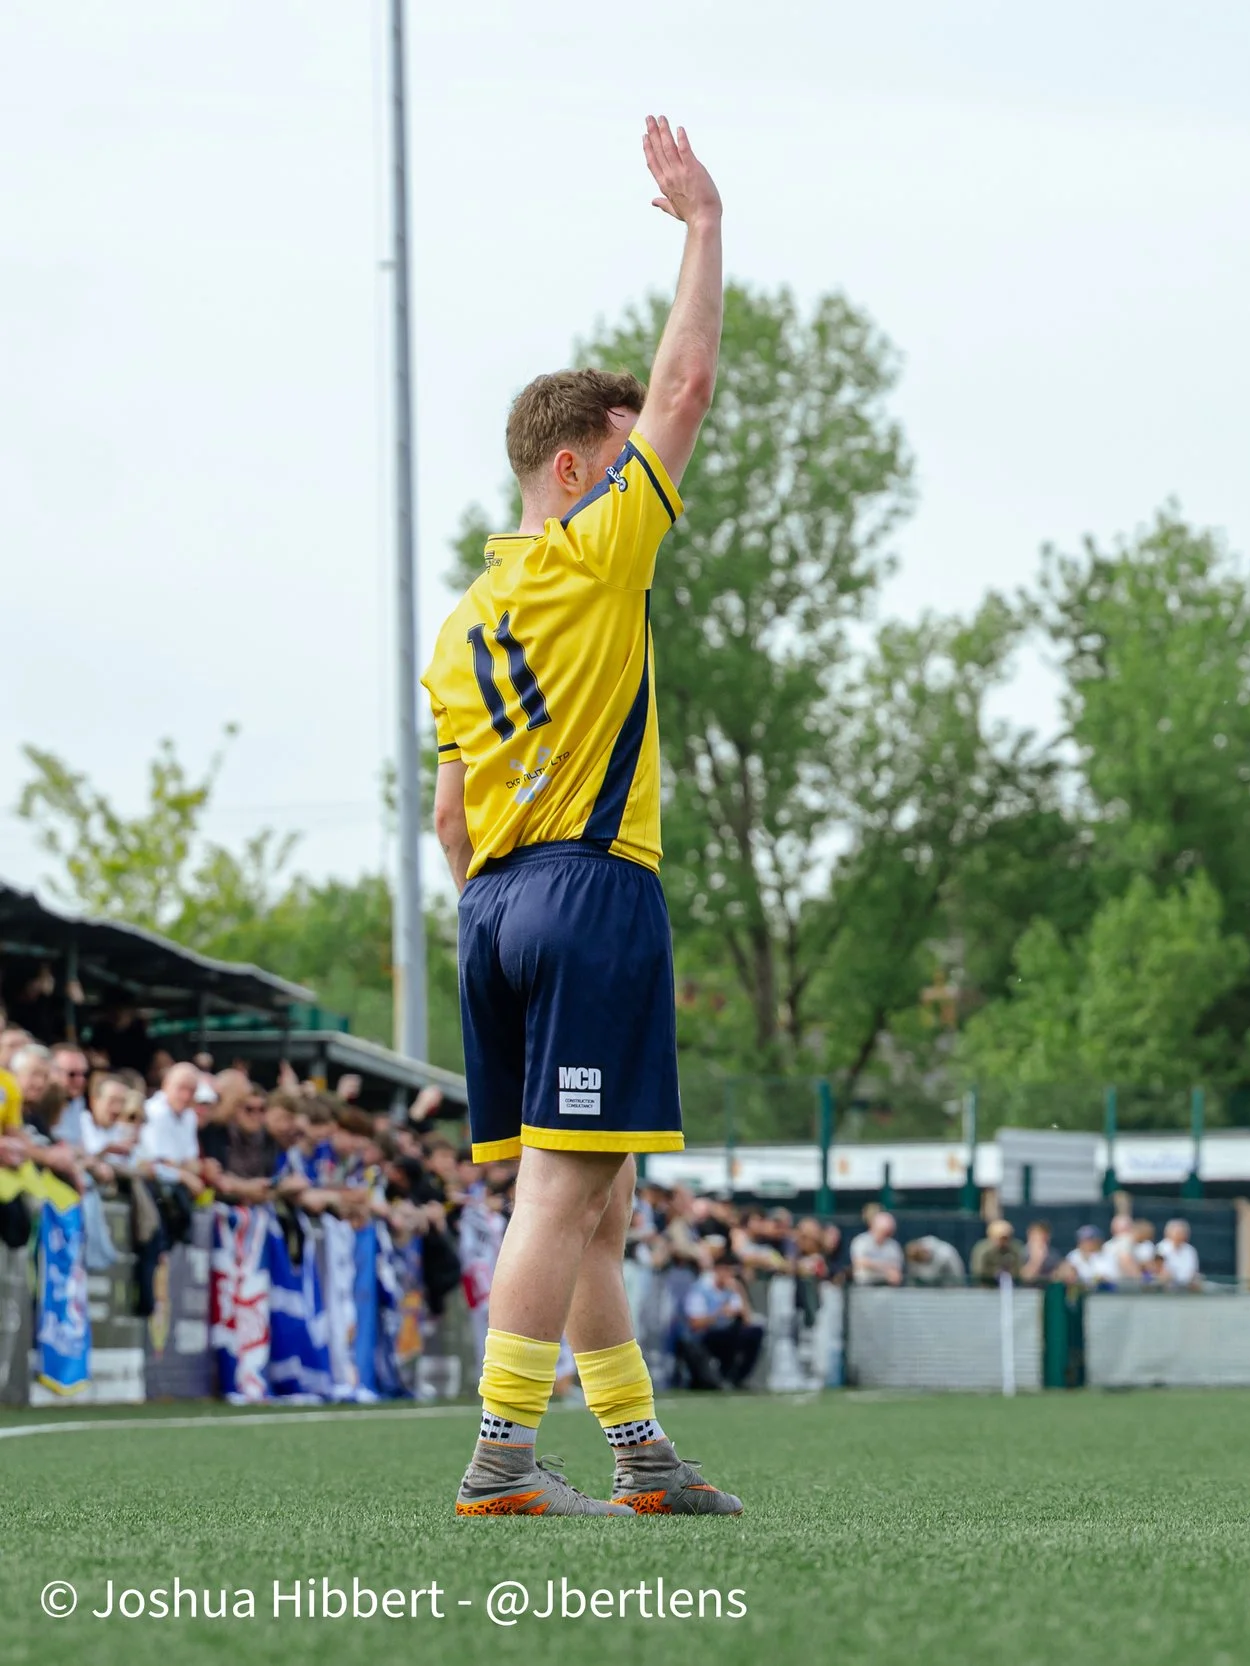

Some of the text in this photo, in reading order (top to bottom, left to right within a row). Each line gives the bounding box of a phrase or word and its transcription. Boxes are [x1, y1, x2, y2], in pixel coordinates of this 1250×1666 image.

[467, 610, 552, 742] 11
[550, 751, 570, 766] LTD
[559, 1067, 601, 1090] MCD
